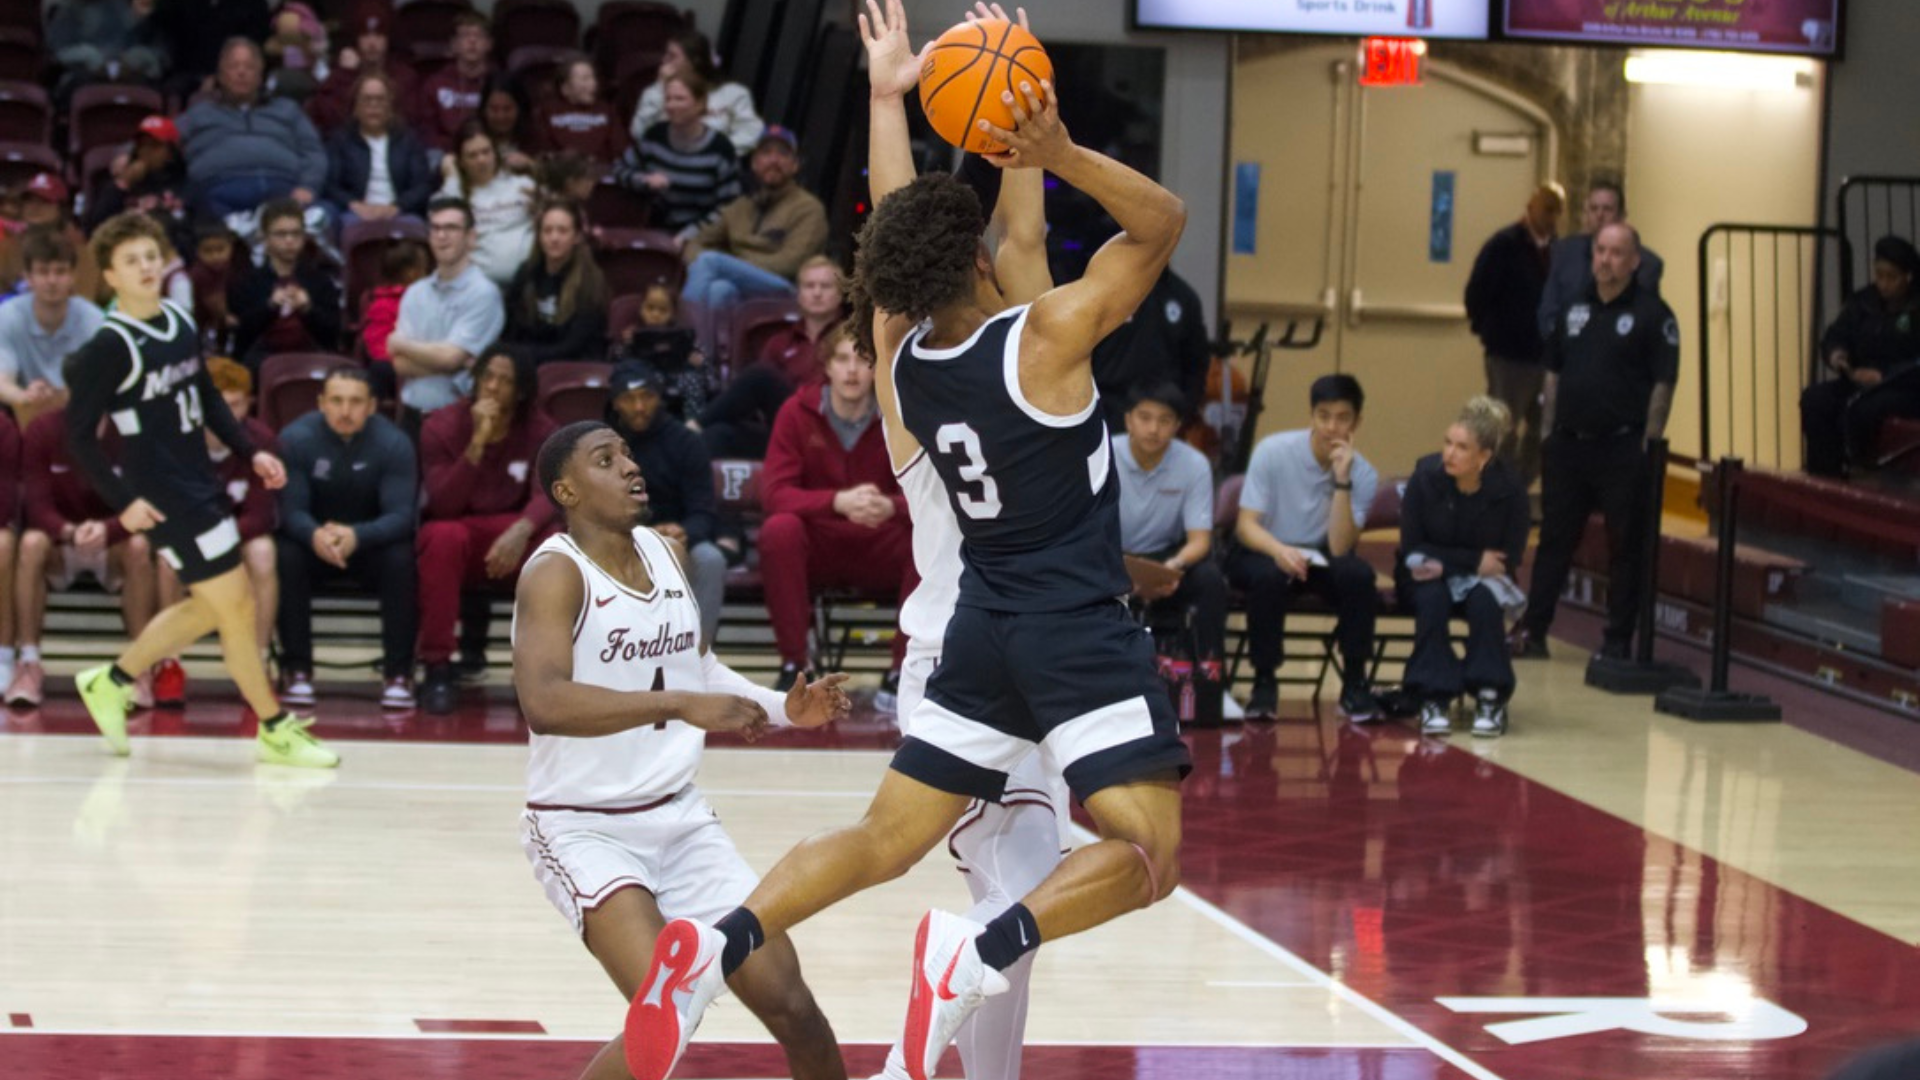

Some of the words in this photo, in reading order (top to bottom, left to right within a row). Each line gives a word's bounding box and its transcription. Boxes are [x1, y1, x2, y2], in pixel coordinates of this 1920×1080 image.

[1296, 0, 1348, 13] Sports
[1354, 0, 1396, 13] Drink
[1619, 2, 1677, 21] Arthur
[1681, 5, 1740, 24] Avenue
[174, 384, 204, 434] 14
[721, 460, 751, 500] F
[936, 422, 1003, 519] 3
[599, 621, 695, 663] Fordham
[1433, 997, 1808, 1045] R
